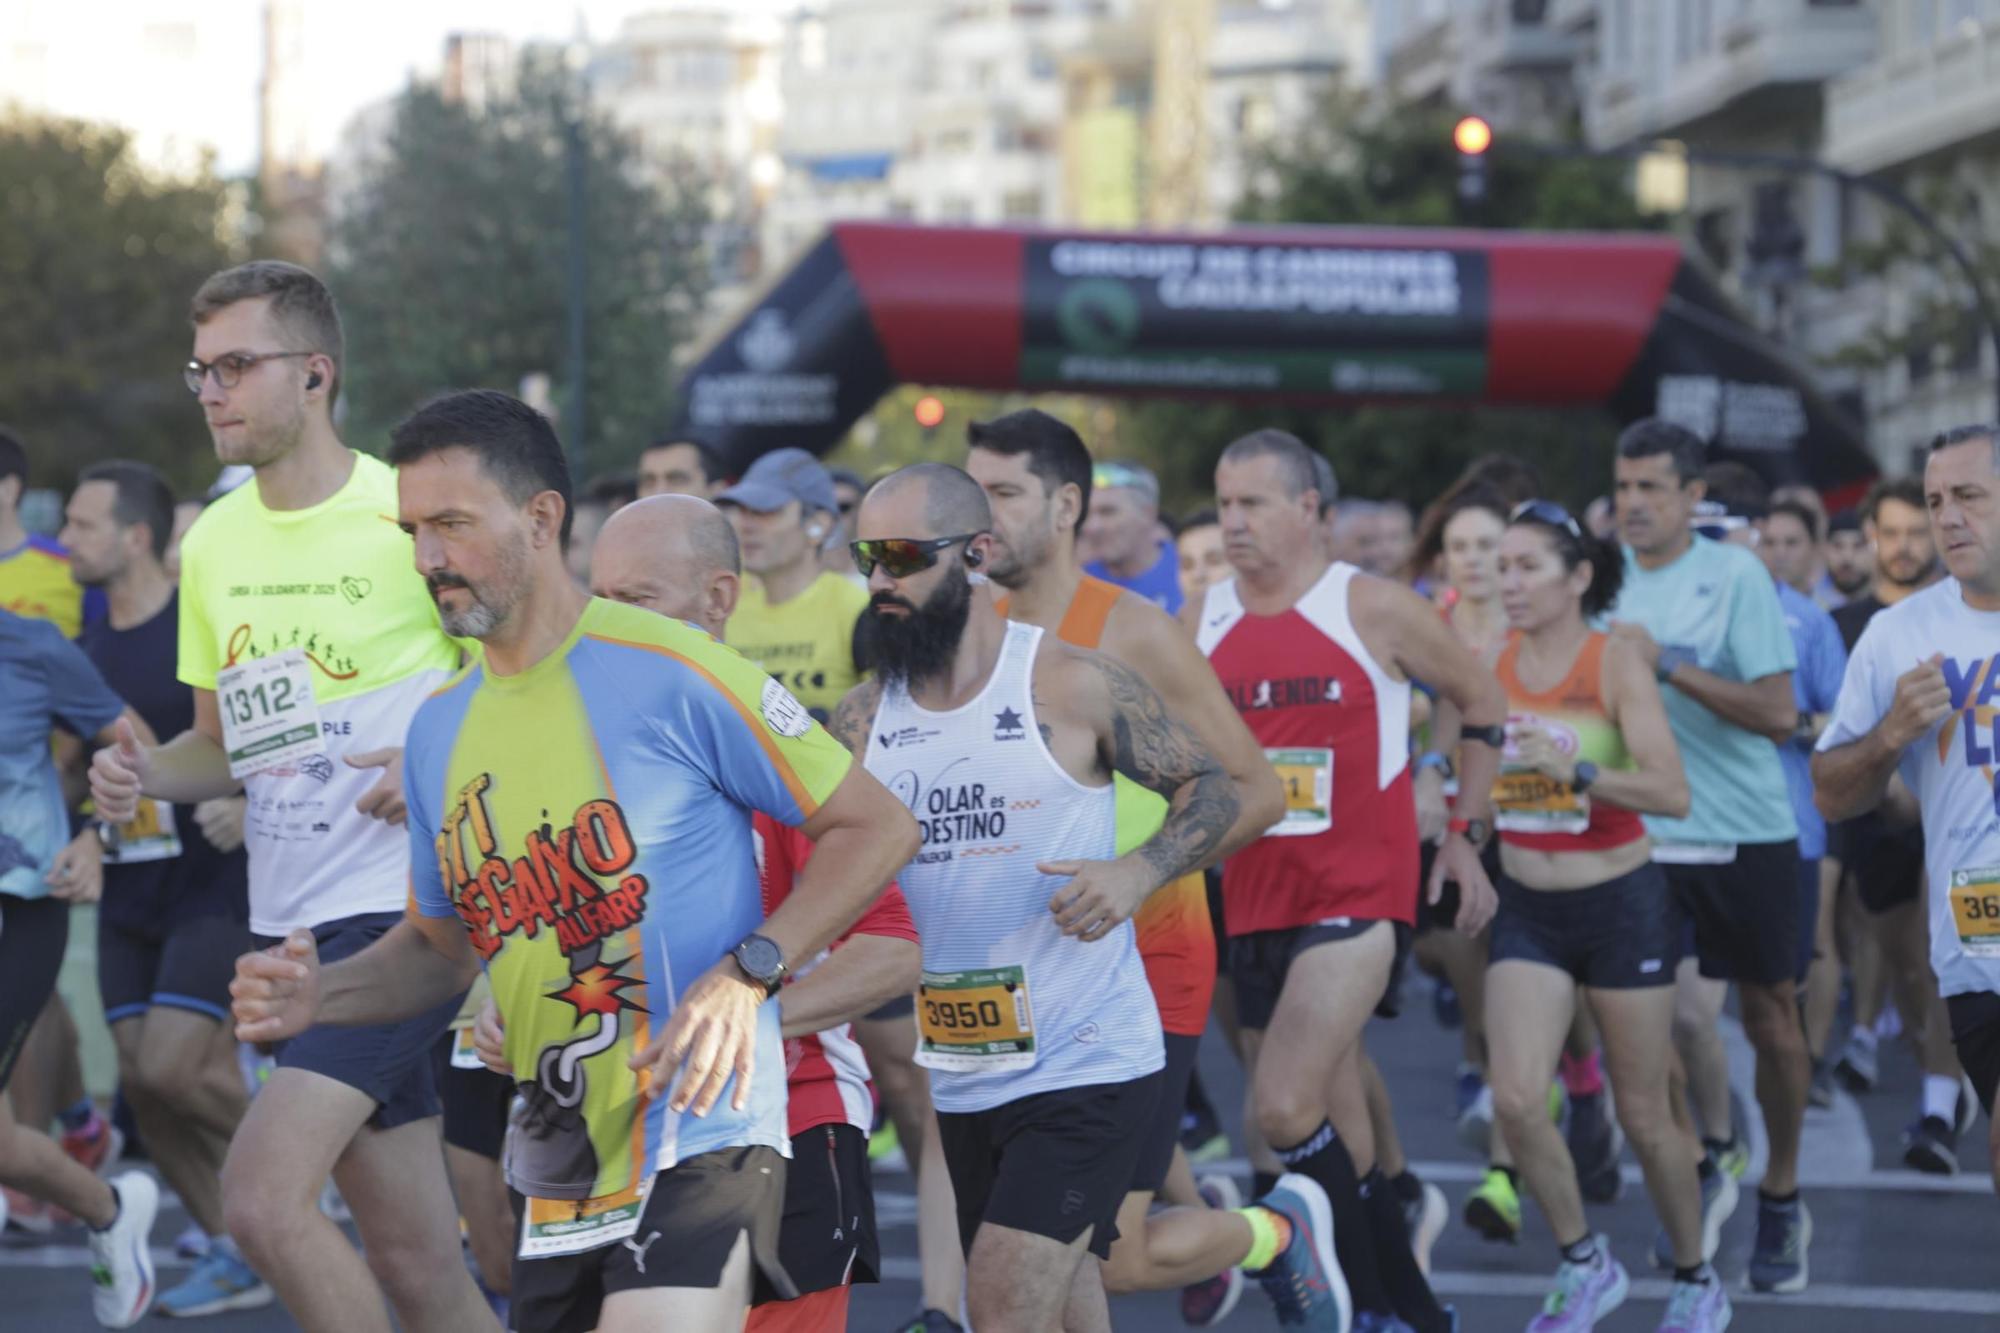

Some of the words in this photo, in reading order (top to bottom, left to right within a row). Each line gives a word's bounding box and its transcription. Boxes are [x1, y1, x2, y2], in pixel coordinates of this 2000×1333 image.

[224, 676, 297, 726] 1312
[919, 811, 1006, 845] DESTINO
[555, 873, 649, 957] ALFARP
[925, 999, 1001, 1028] 3950
